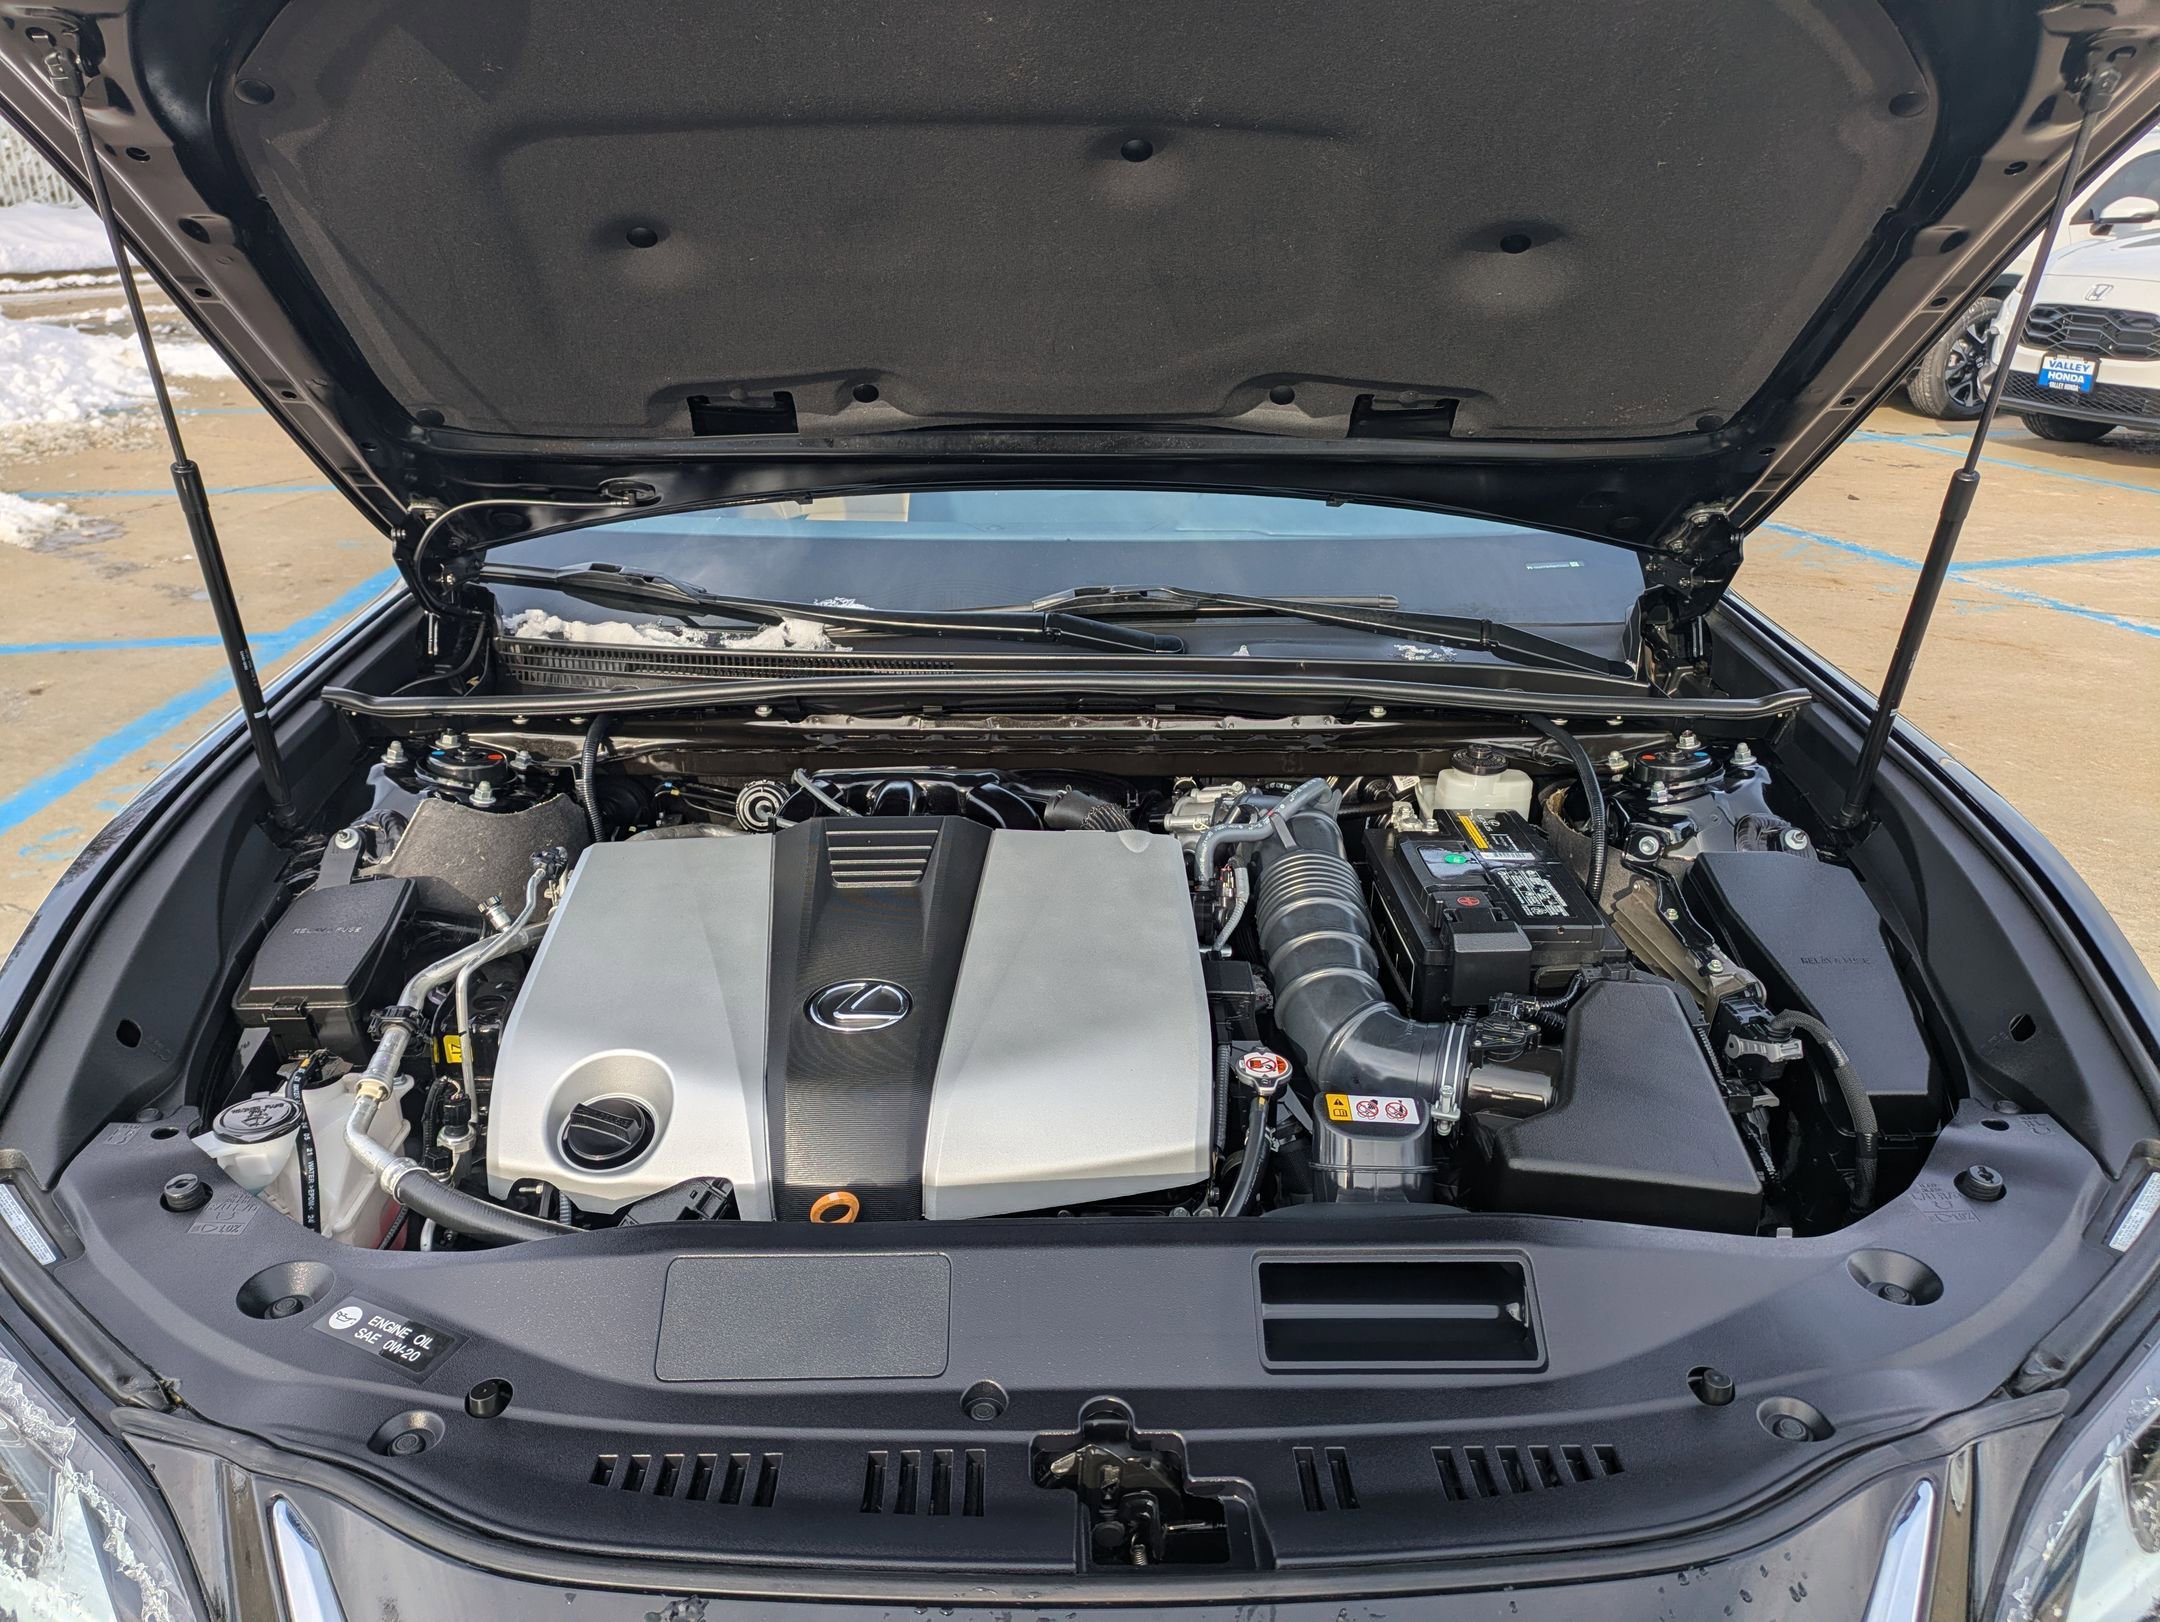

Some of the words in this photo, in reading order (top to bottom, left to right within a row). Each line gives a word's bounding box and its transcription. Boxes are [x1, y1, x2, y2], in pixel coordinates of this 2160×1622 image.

[2047, 371, 2085, 383] HONDA
[2048, 360, 2090, 372] VALLEY
[307, 1160, 315, 1184] WATER
[367, 1315, 413, 1340] ENGINE
[412, 1334, 434, 1350] OIL
[354, 1328, 383, 1345] SAE
[382, 1339, 422, 1363] 0W-20
